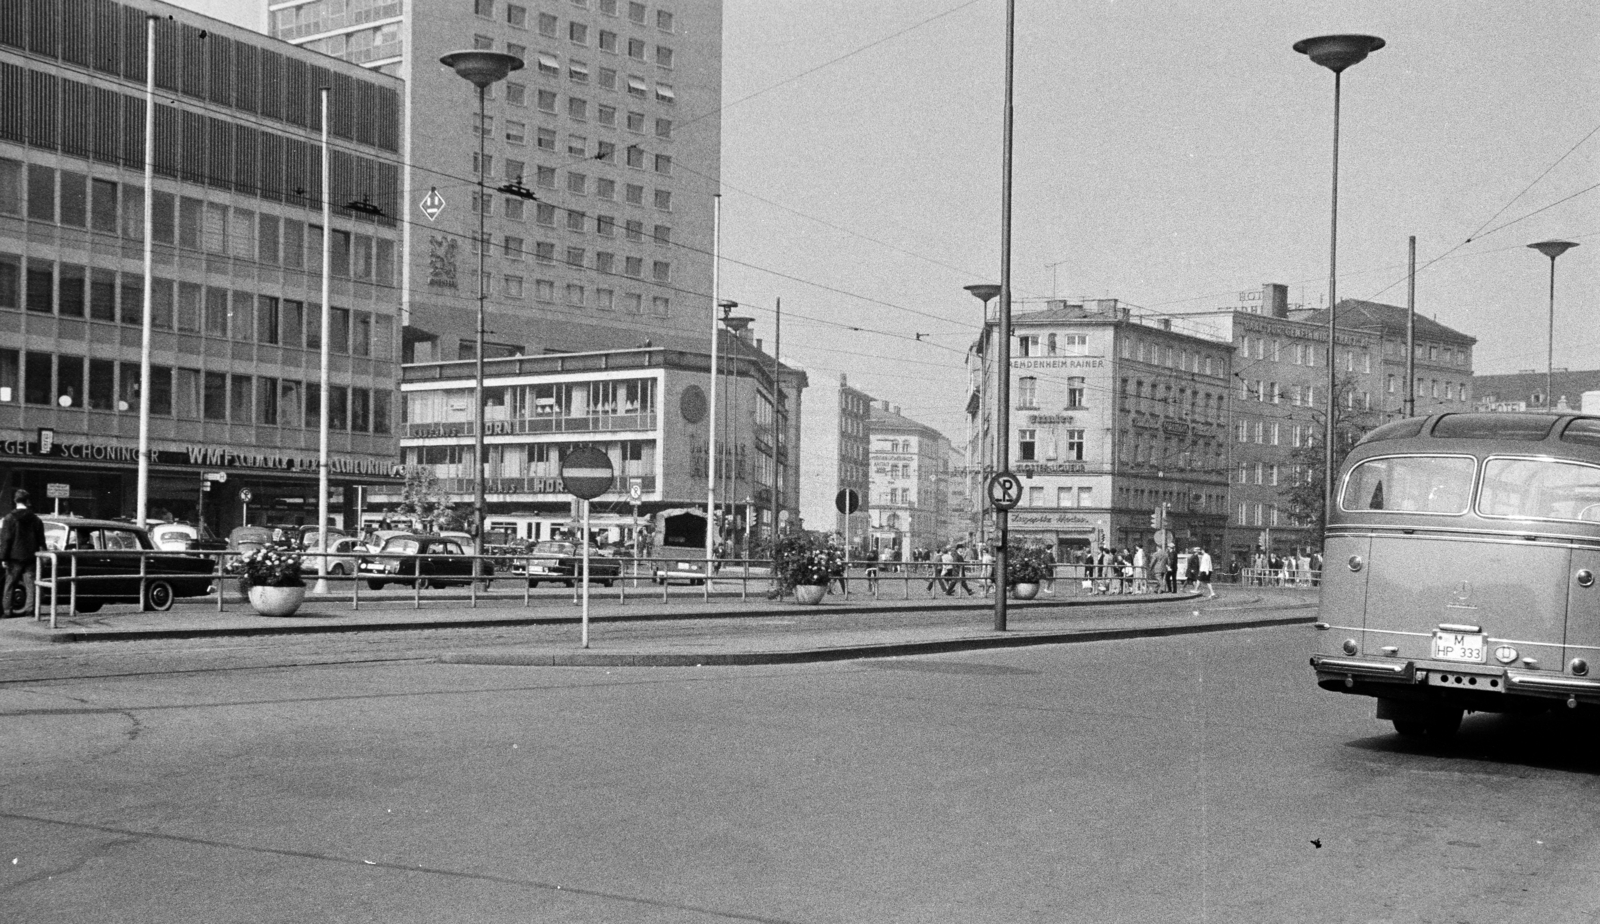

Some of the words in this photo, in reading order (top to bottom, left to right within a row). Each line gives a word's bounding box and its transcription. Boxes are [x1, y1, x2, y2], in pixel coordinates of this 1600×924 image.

[1009, 360, 1067, 369] REMDENHEIM
[1070, 360, 1104, 369] RAINER
[484, 419, 513, 436] ORN
[0, 439, 33, 455] GEL
[187, 446, 232, 466] WMF
[534, 478, 568, 493] HOR
[1454, 635, 1465, 647] M
[1437, 645, 1454, 657] HP
[1460, 647, 1481, 659] 333
